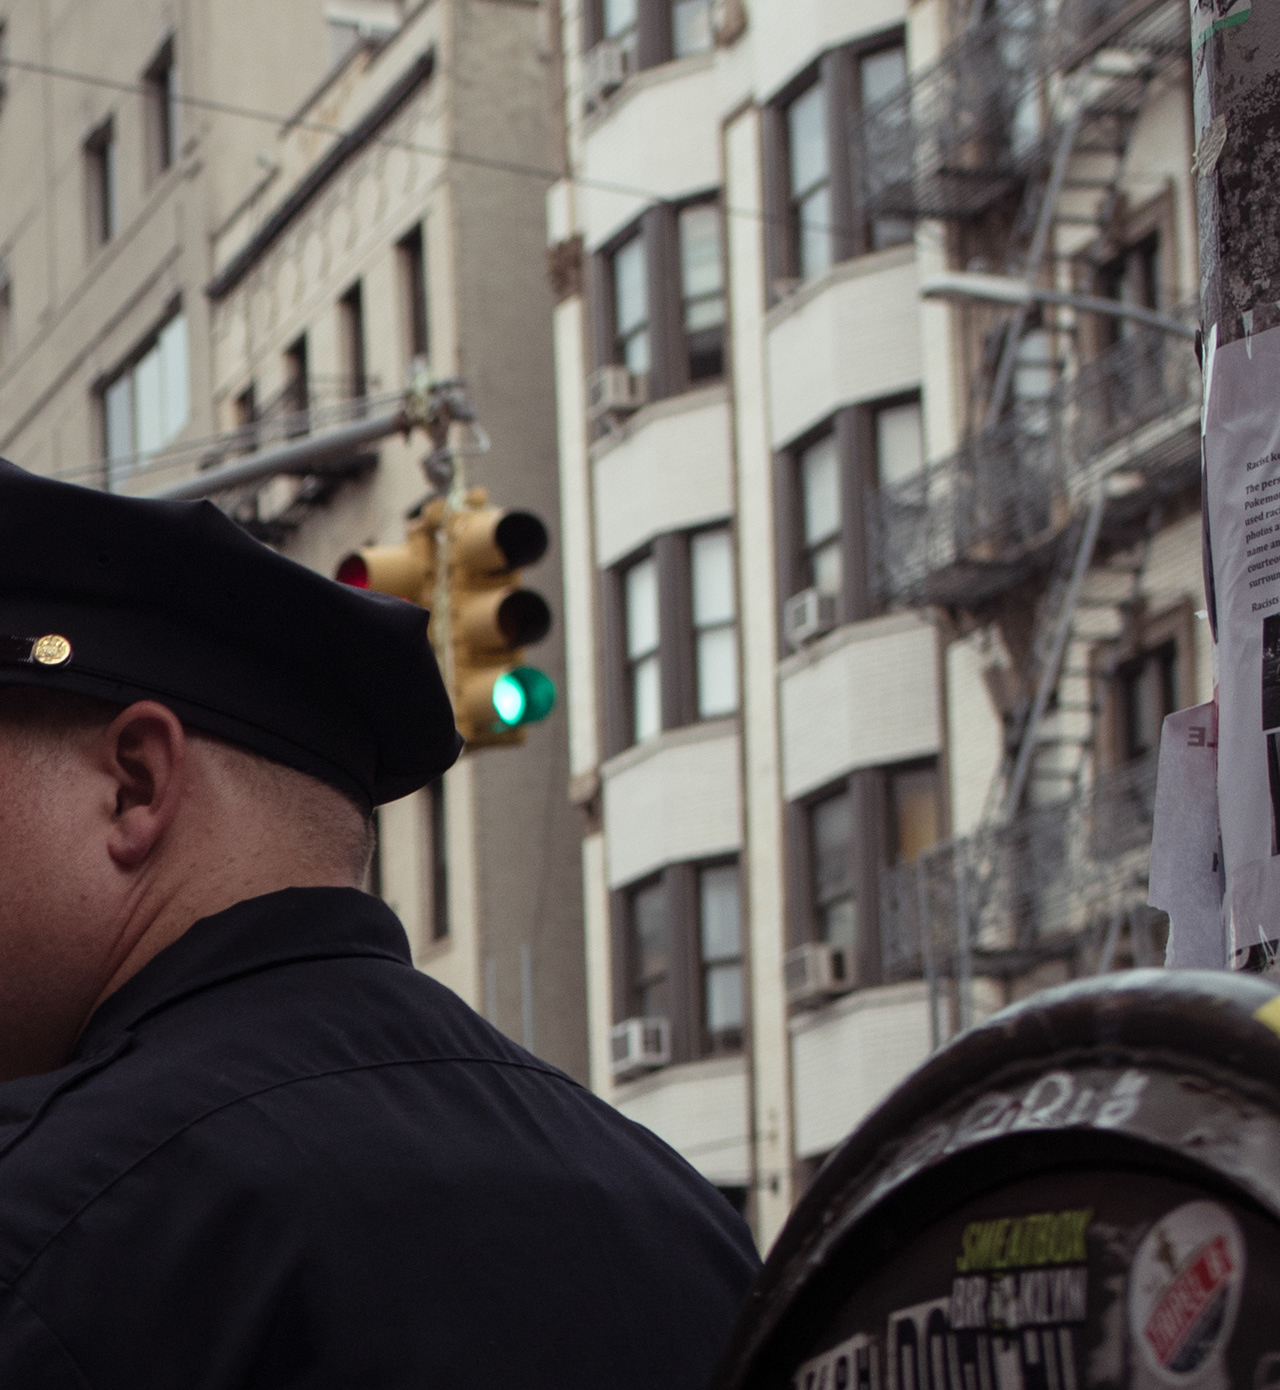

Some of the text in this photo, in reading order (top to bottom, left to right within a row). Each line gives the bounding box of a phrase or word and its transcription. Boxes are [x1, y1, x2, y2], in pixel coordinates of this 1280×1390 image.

[1245, 484, 1259, 495] The
[1244, 511, 1264, 527] used
[1245, 525, 1273, 545] photos
[1246, 543, 1269, 558] name
